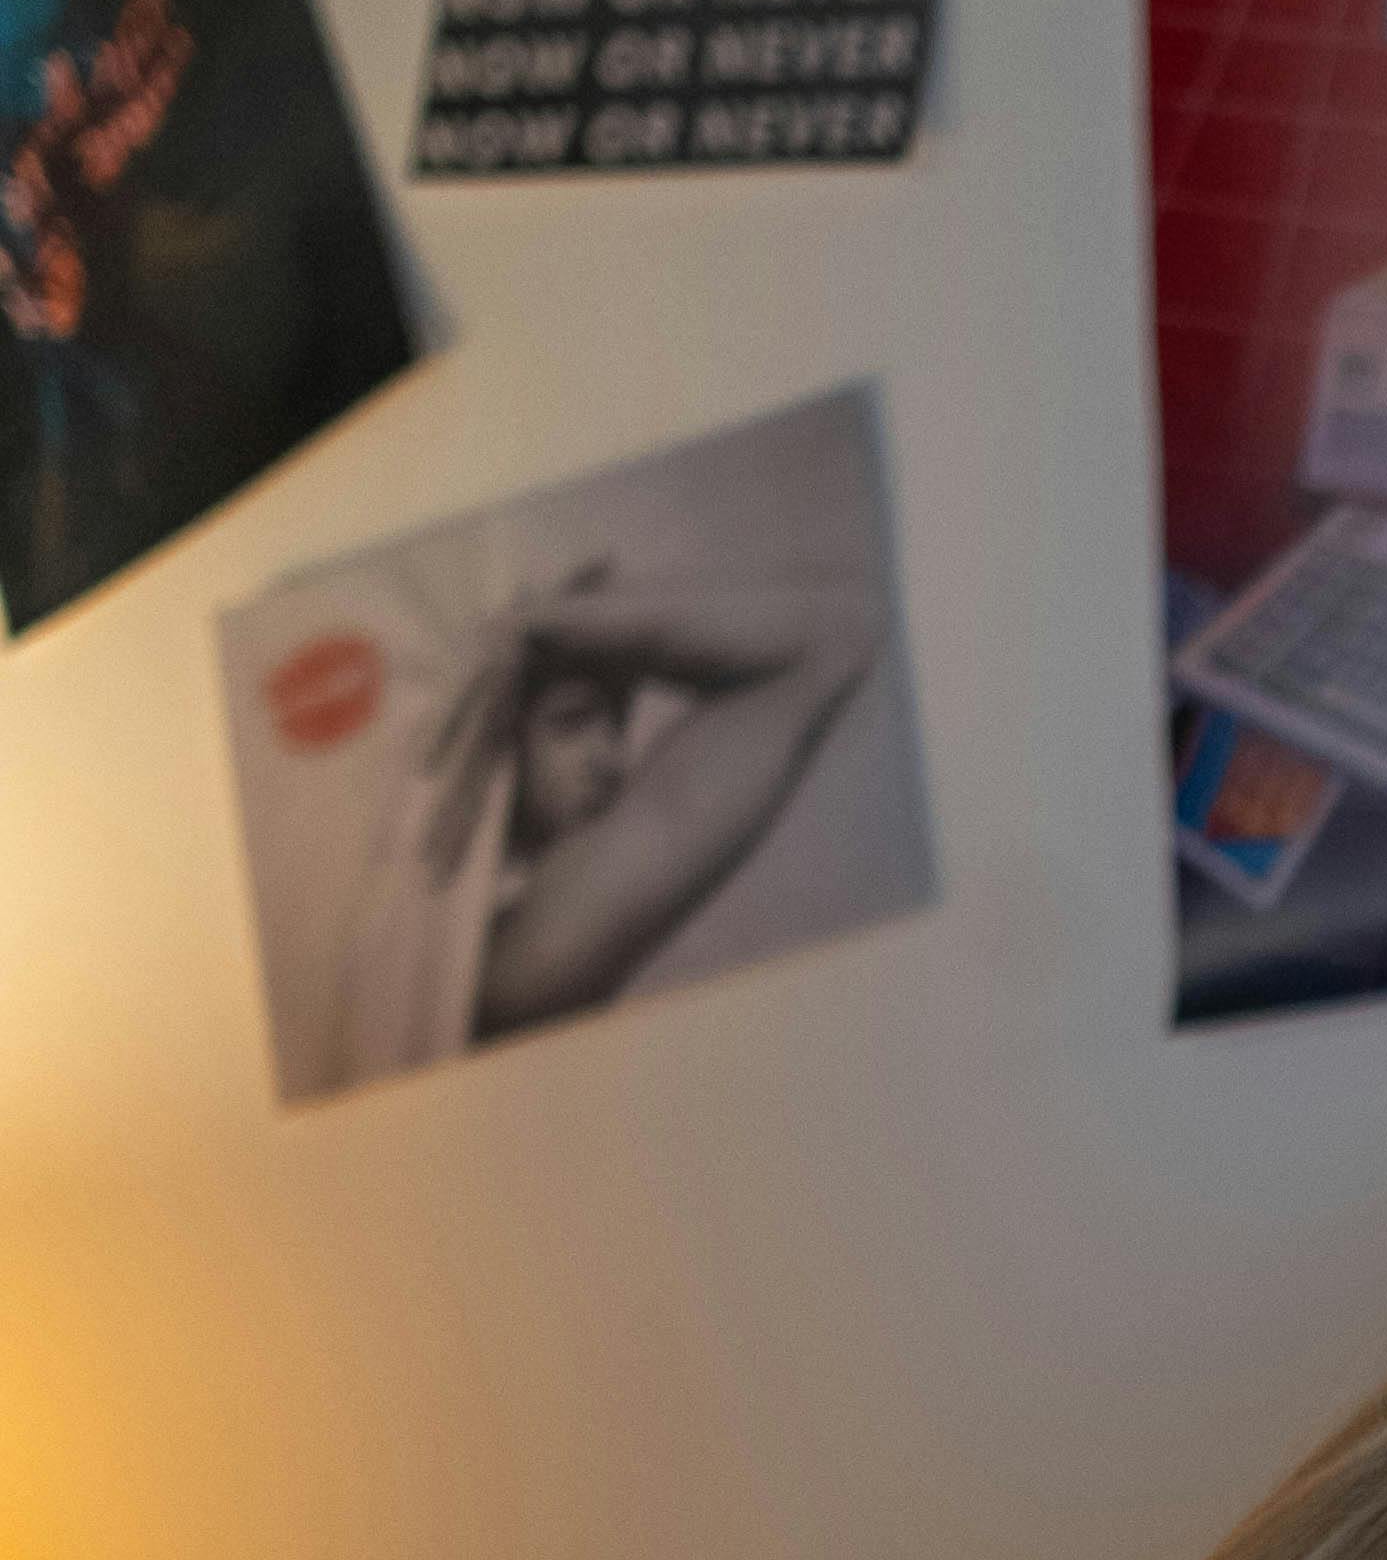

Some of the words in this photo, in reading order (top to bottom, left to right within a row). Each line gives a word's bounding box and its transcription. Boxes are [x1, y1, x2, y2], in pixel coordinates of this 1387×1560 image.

[432, 35, 590, 97] NOW
[593, 27, 692, 90] OR
[702, 13, 920, 85] NEVER
[420, 110, 582, 168] NOW
[585, 102, 683, 160] OR
[693, 90, 908, 155] NEVER
